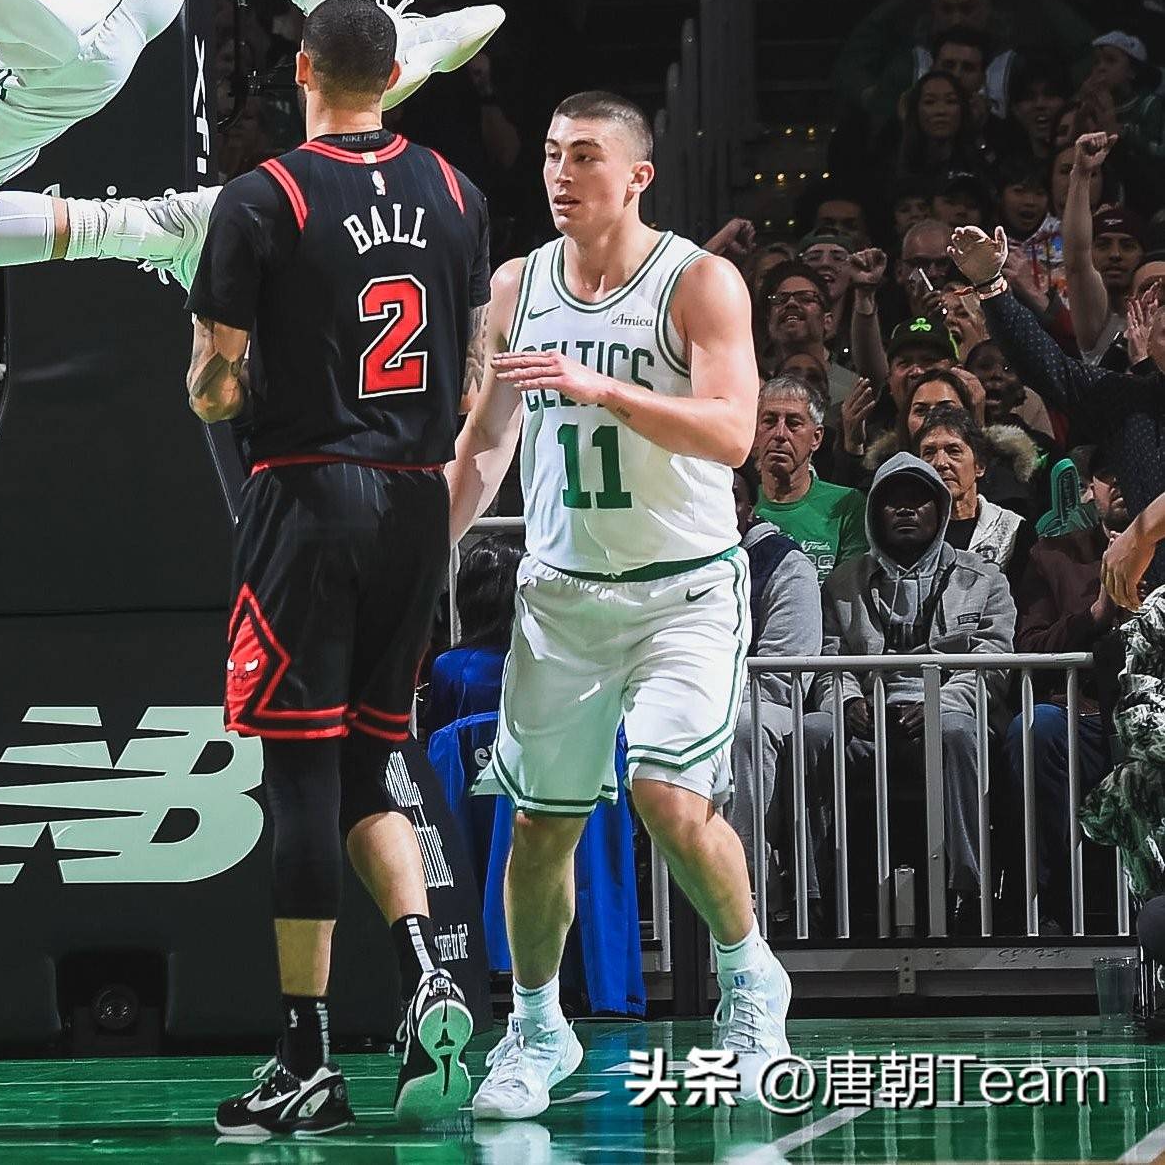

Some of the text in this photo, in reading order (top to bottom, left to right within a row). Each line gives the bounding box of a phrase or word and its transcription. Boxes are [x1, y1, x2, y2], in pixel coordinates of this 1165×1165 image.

[342, 203, 428, 255] BALL
[357, 273, 428, 399] 2
[611, 313, 654, 328] Amica
[557, 423, 633, 509] 11
